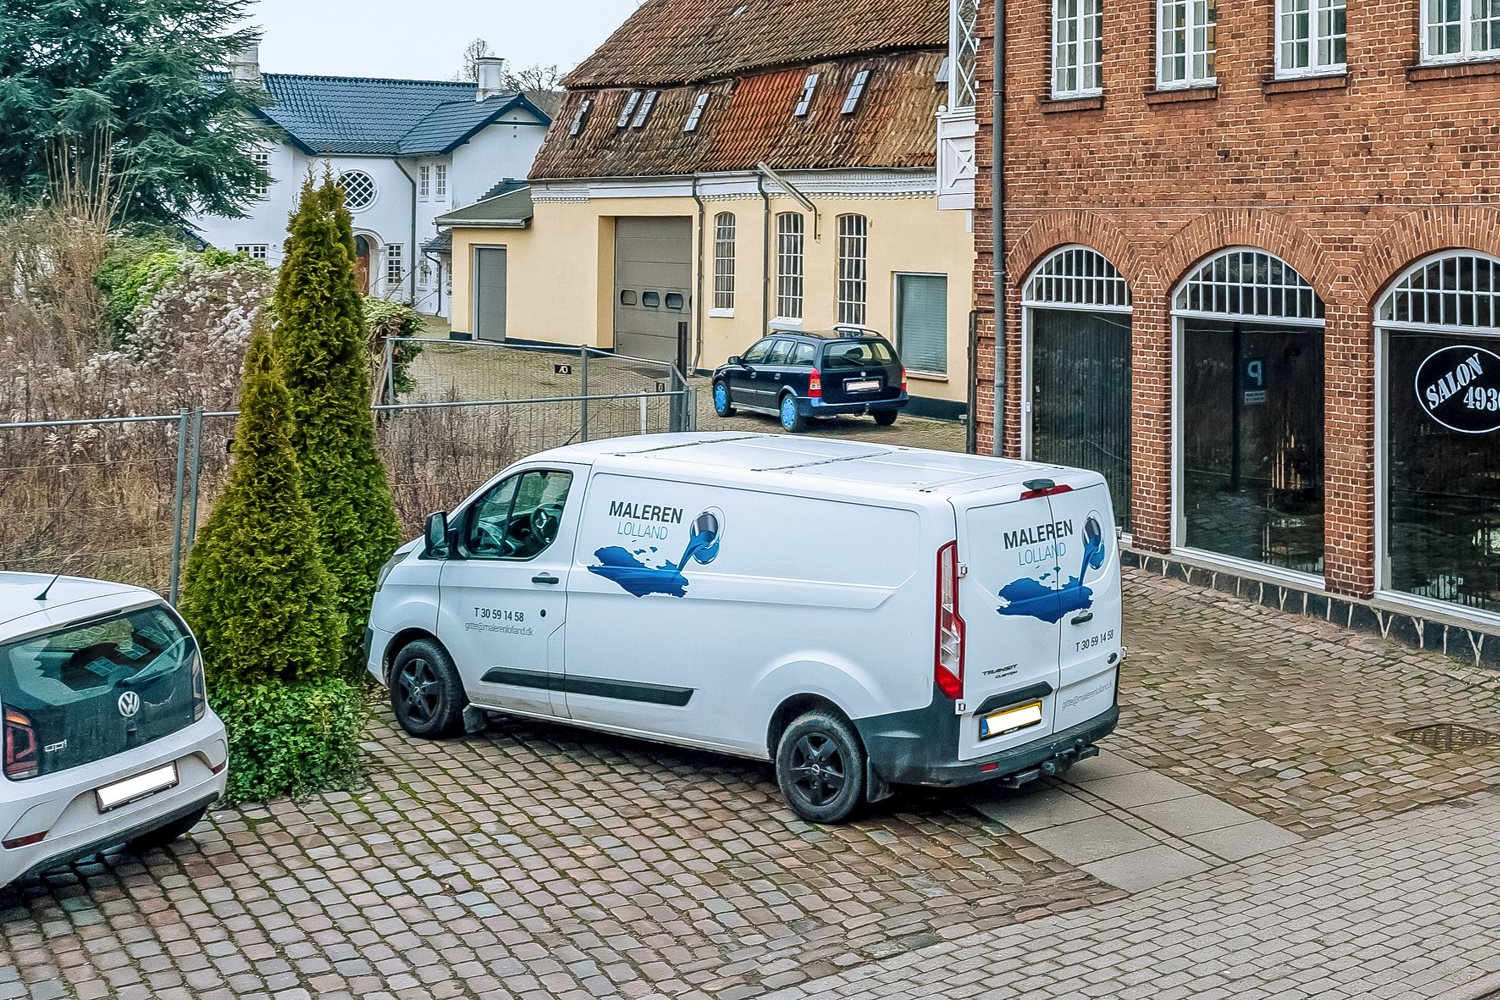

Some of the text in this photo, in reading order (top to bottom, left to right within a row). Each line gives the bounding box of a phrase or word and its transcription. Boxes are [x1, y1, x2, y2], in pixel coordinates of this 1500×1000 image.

[1426, 353, 1483, 410] SALON
[608, 500, 684, 524] MALEREN
[617, 521, 669, 540] LOLLAND
[1003, 519, 1074, 550] MALEREN
[1018, 542, 1067, 566] LOLLAND
[474, 607, 525, 622] T 30 59 14 58
[1076, 641, 1081, 653] T
[1081, 638, 1090, 651] 30
[1090, 635, 1099, 647] 59
[1099, 632, 1107, 644] 14
[982, 663, 1018, 676] TRANSIT
